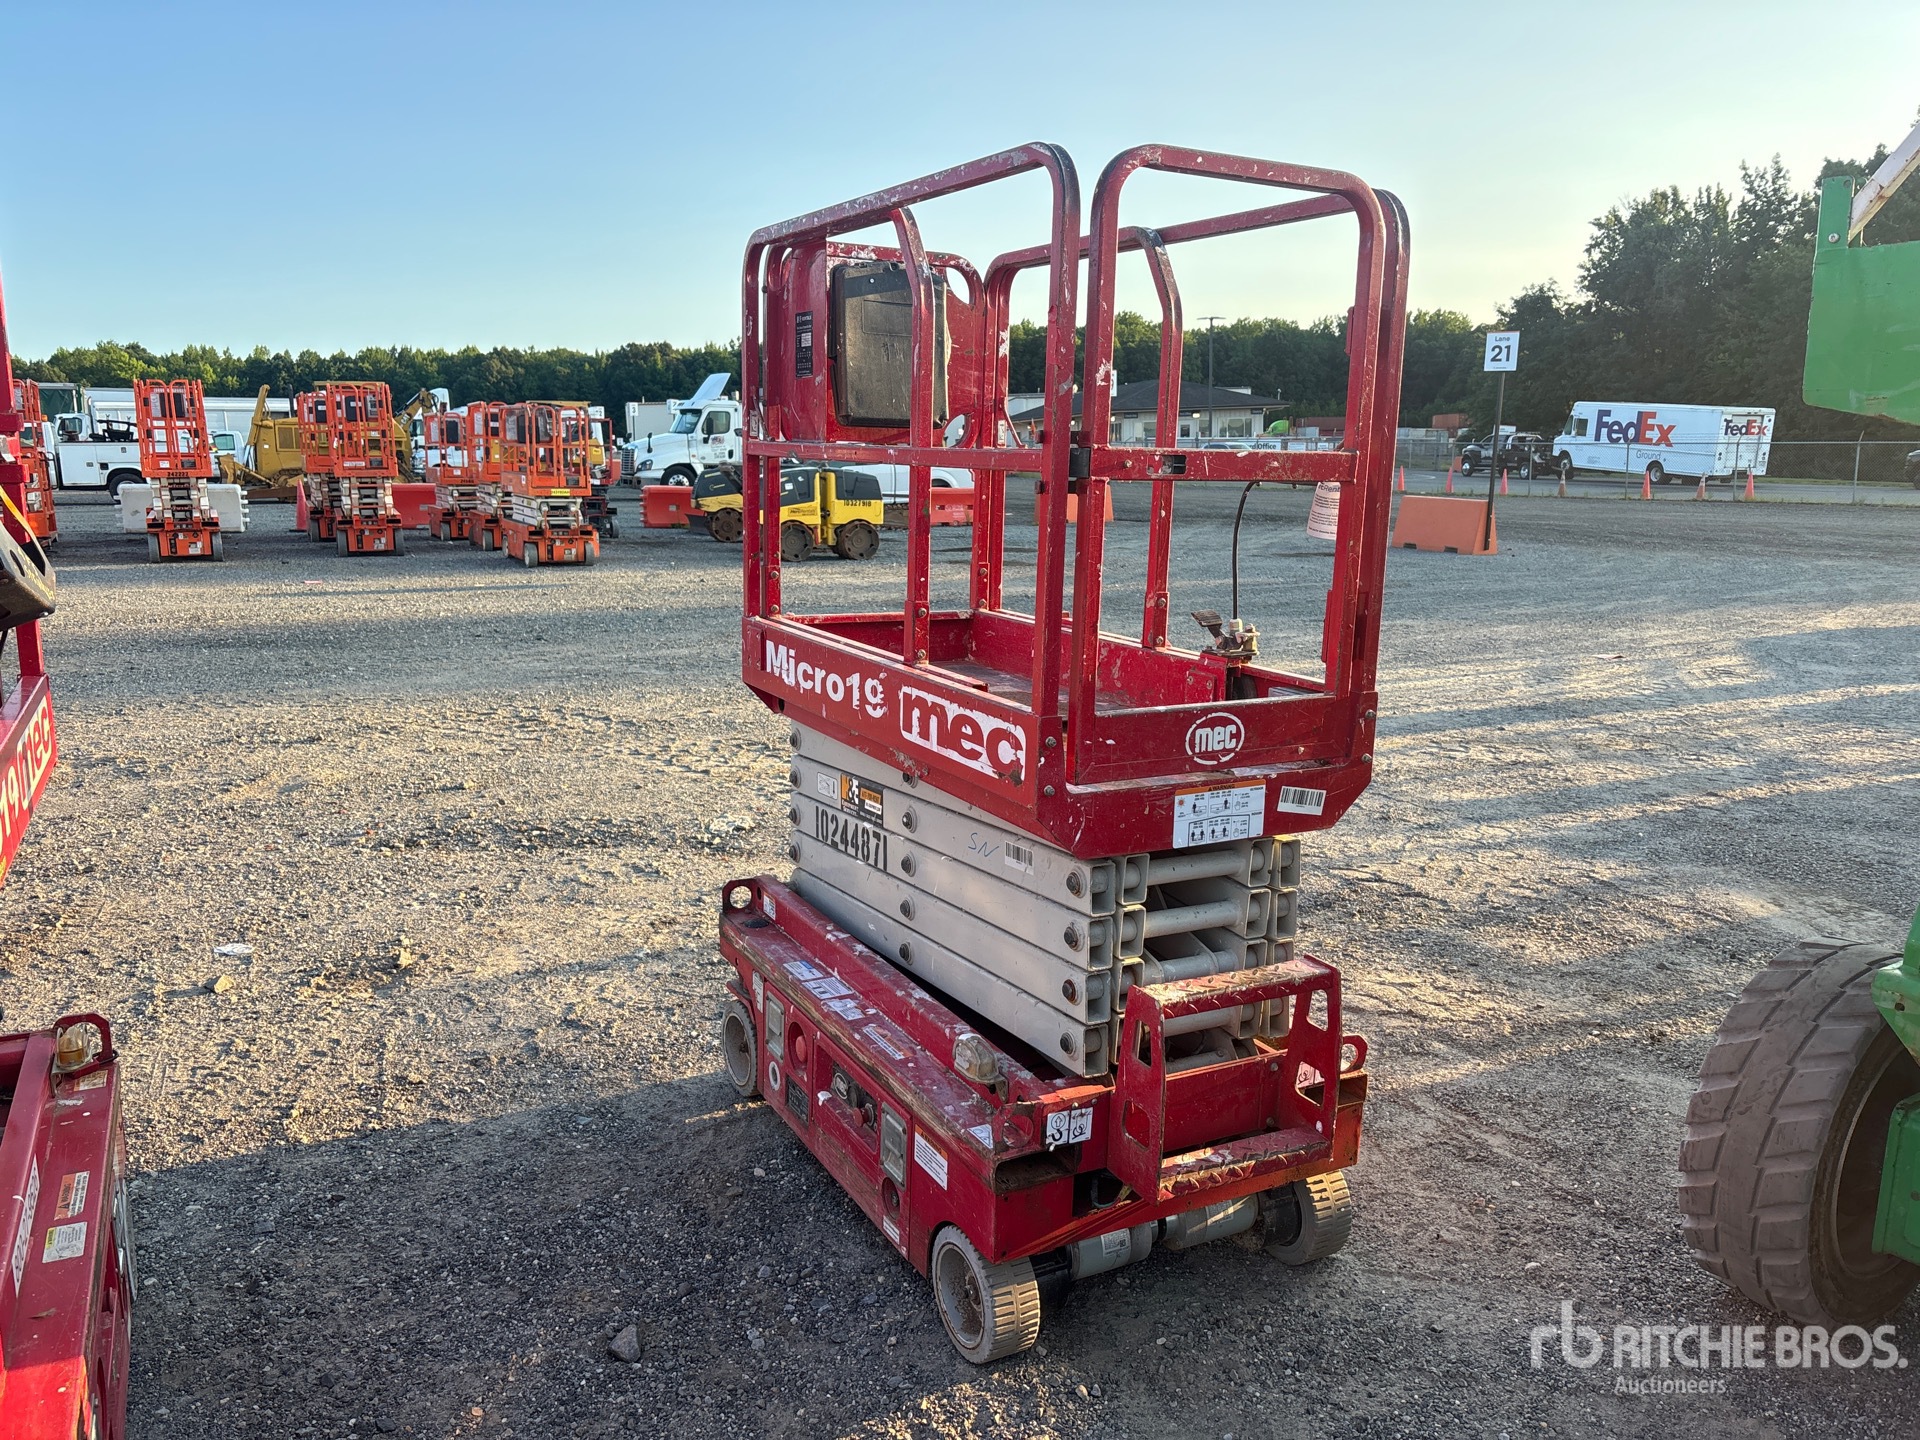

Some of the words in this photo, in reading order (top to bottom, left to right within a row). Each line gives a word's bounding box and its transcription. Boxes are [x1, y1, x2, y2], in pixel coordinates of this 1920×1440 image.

[1490, 345, 1512, 362] 21
[1594, 409, 1677, 448] FedEx
[1724, 418, 1767, 436] FedEx
[1257, 442, 1277, 450] Office
[1636, 449, 1662, 461] Ground
[765, 639, 888, 719] Micro19
[900, 685, 1027, 782] mec
[1194, 724, 1237, 753] mec
[815, 805, 888, 872] 10244871
[967, 832, 1000, 858] SN
